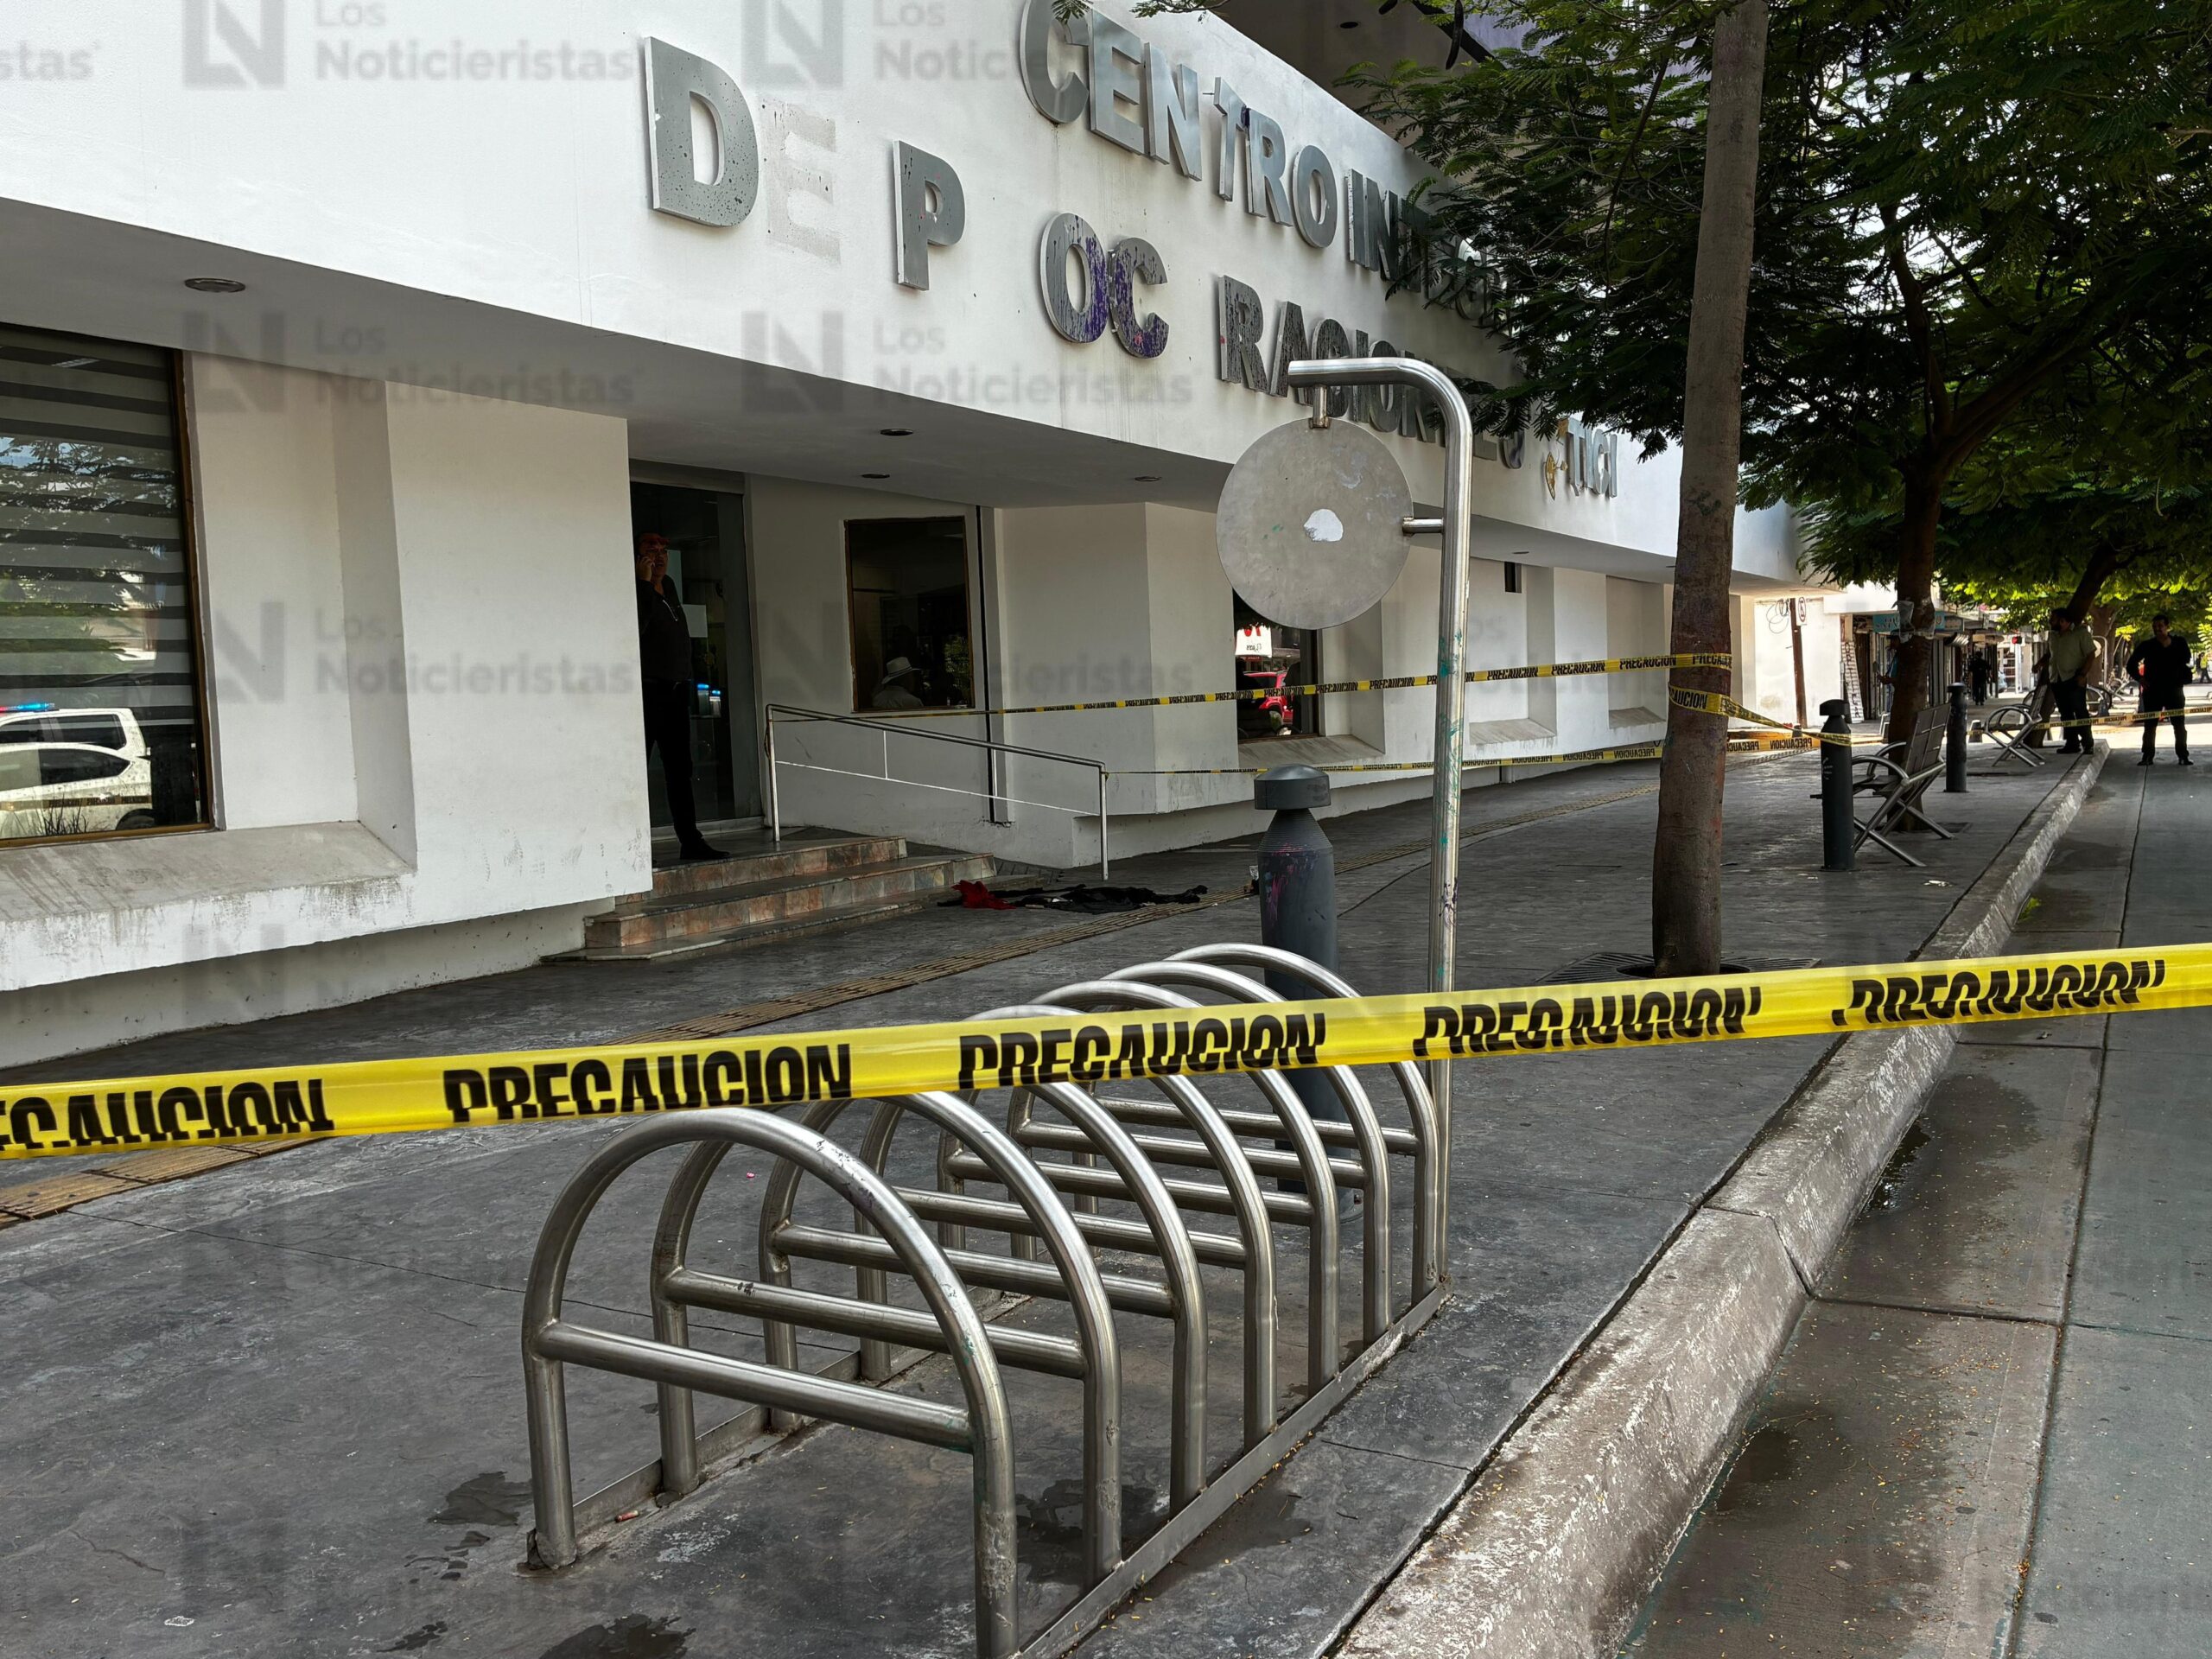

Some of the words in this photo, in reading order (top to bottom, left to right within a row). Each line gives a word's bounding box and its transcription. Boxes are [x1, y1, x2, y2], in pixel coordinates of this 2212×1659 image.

[1020, 0, 1338, 248] CENTRO
[1486, 666, 1539, 681] PRECAUCION
[1551, 659, 1605, 676] PRECAUCION
[0, 1077, 334, 1153] CAUCION
[443, 1043, 852, 1124] PRECAUCION
[957, 1012, 1326, 1090] PRECAUCION
[1413, 986, 1762, 1057] PRECAUCION
[1831, 959, 2165, 1027] PRECAUCION
